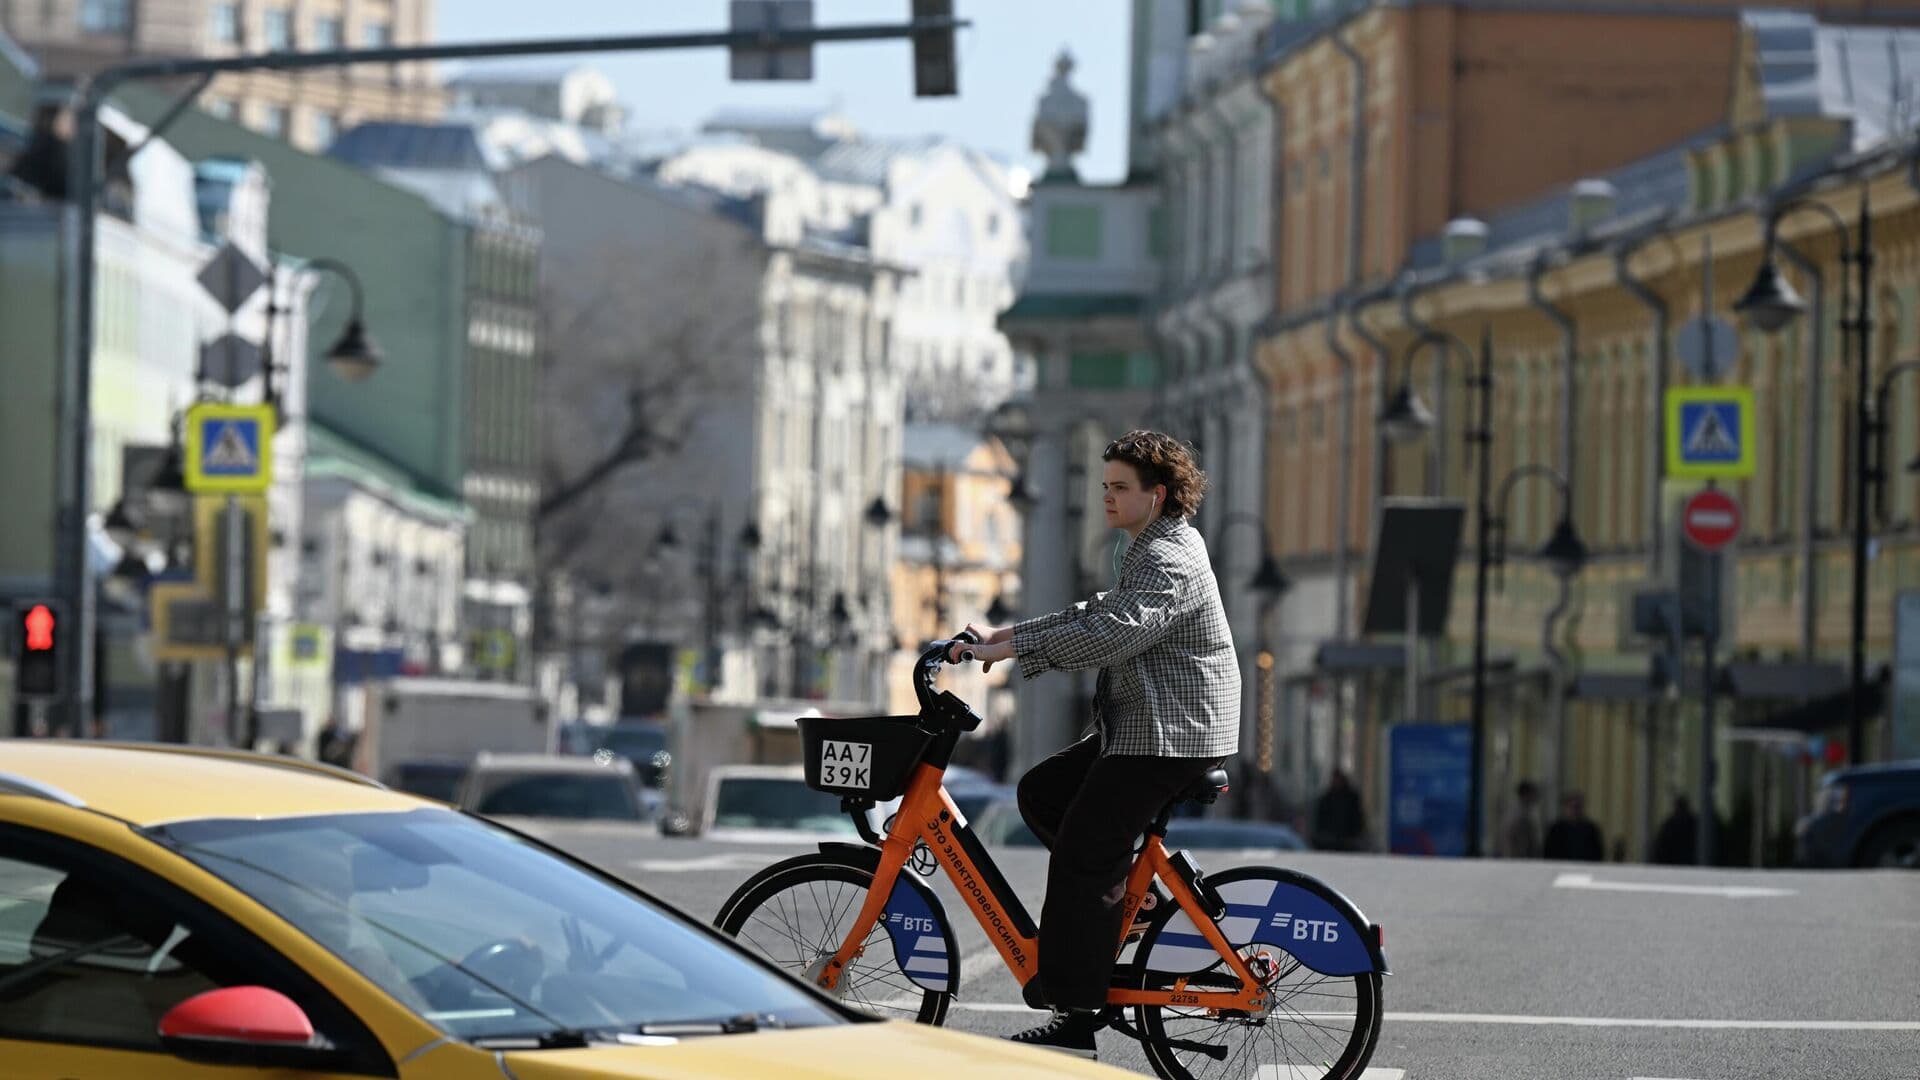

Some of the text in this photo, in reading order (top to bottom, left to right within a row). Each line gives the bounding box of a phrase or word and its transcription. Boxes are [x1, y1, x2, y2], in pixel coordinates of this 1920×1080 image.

[928, 818, 1026, 968] Это электровелосипед.
[903, 917, 933, 932] ВТБ
[1292, 919, 1339, 942] ВТБ
